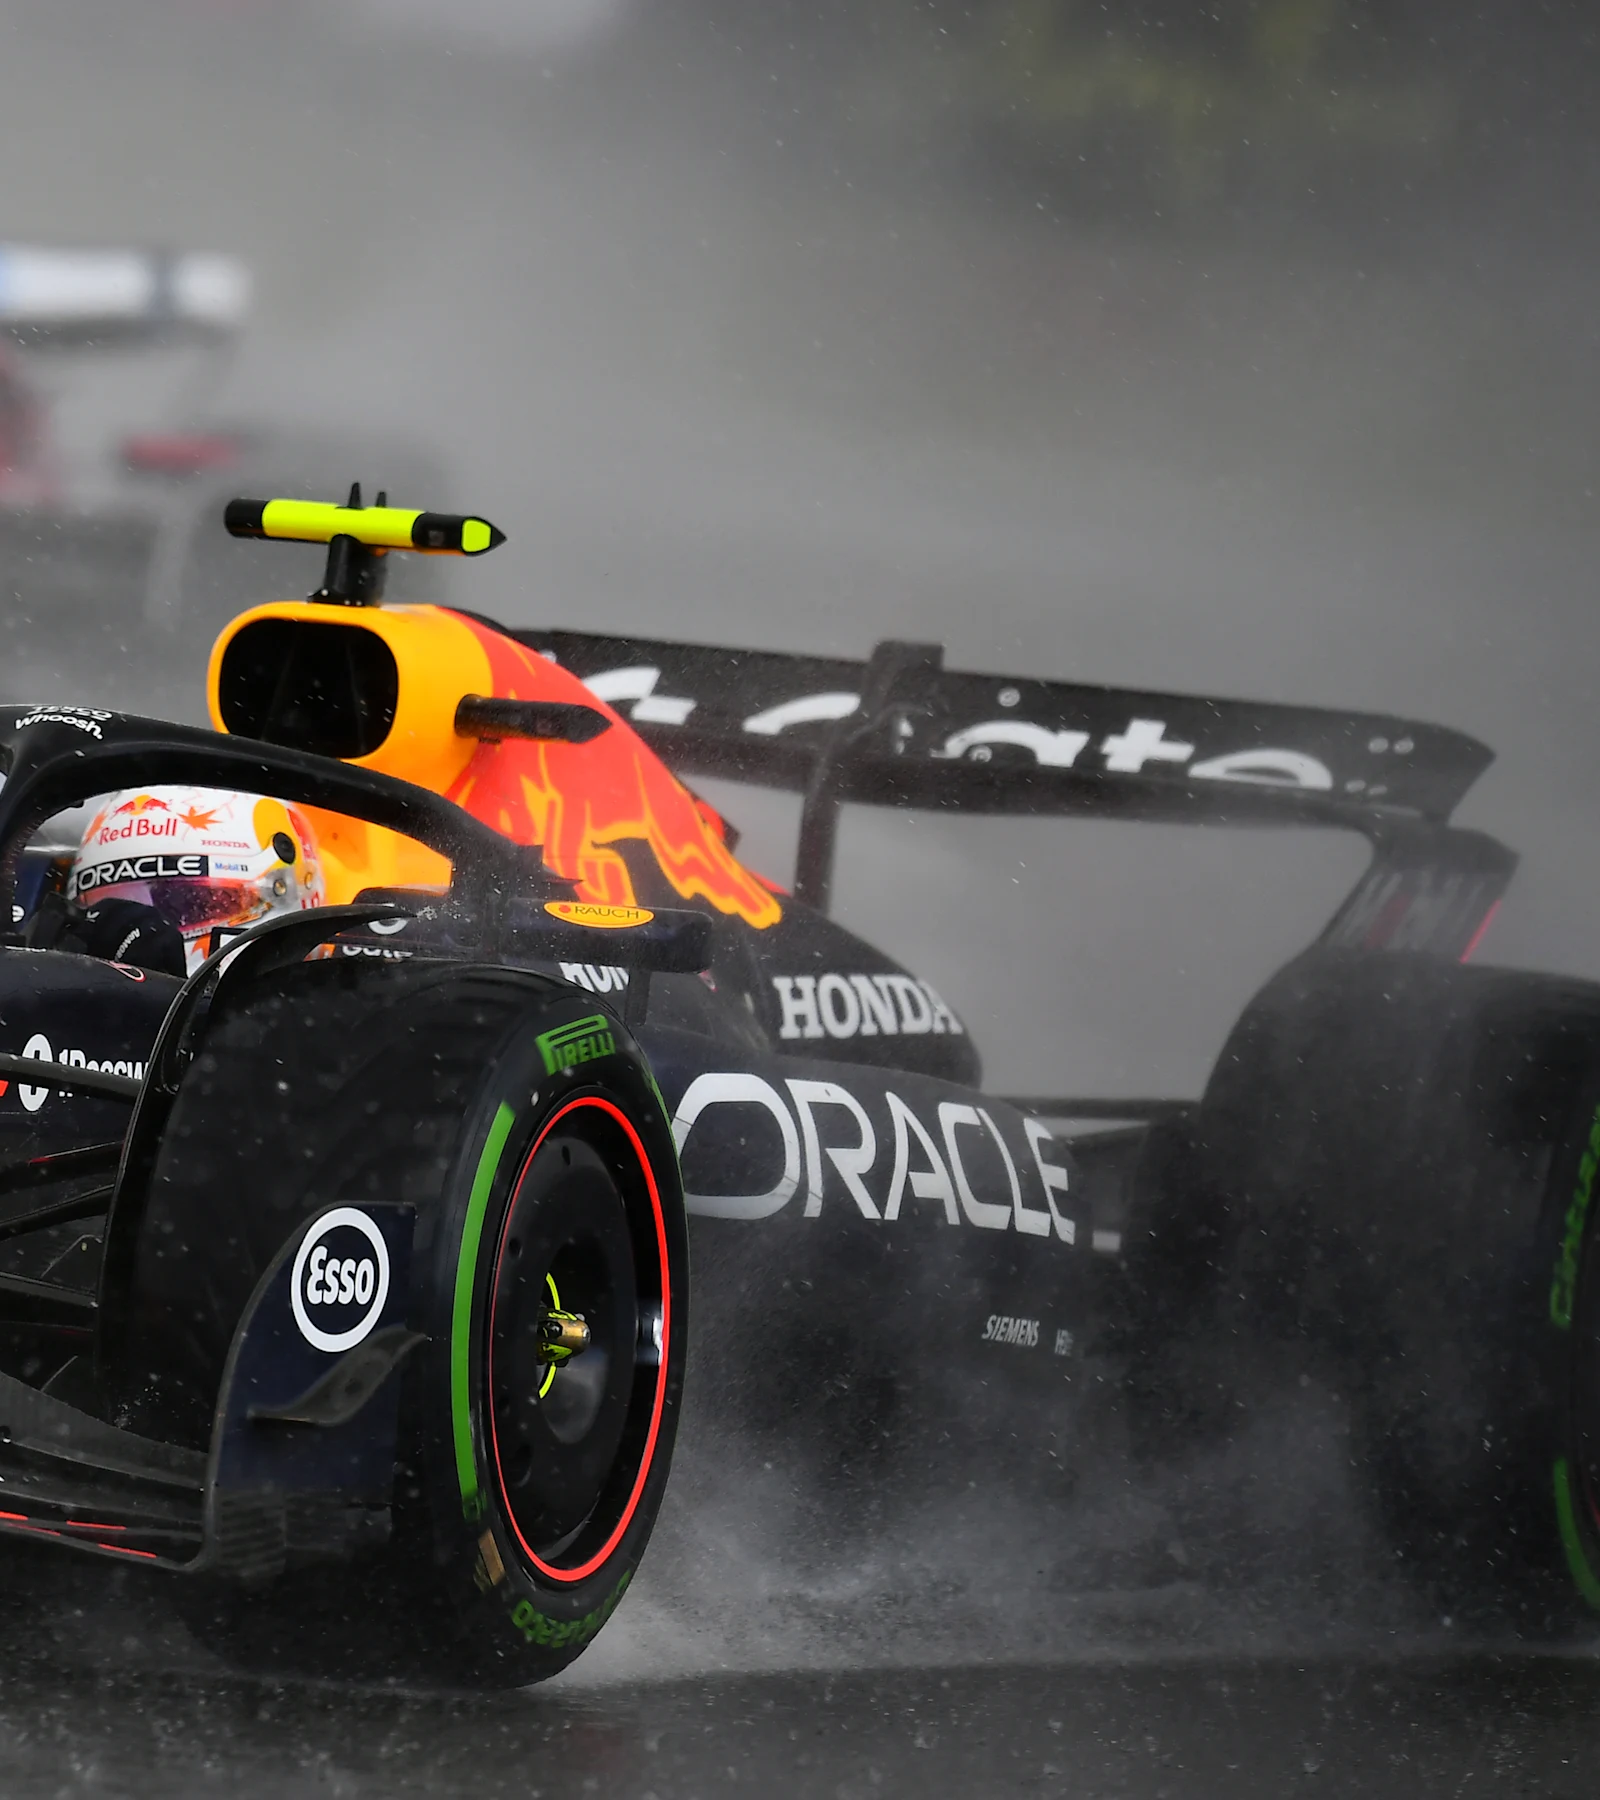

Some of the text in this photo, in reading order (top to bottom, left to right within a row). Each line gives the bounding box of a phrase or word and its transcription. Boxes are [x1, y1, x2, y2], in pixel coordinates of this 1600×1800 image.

[99, 817, 178, 845] Red Bull
[200, 840, 251, 849] HONDA
[78, 855, 202, 891] ORACLE
[214, 862, 239, 872] Mobil
[573, 905, 640, 920] RAUCH
[772, 973, 964, 1040] HONDA
[534, 1013, 617, 1077] PIRELLI
[671, 1073, 1077, 1245] ORACLE
[307, 1245, 374, 1305] Esso
[981, 1314, 1040, 1347] SIEMENS
